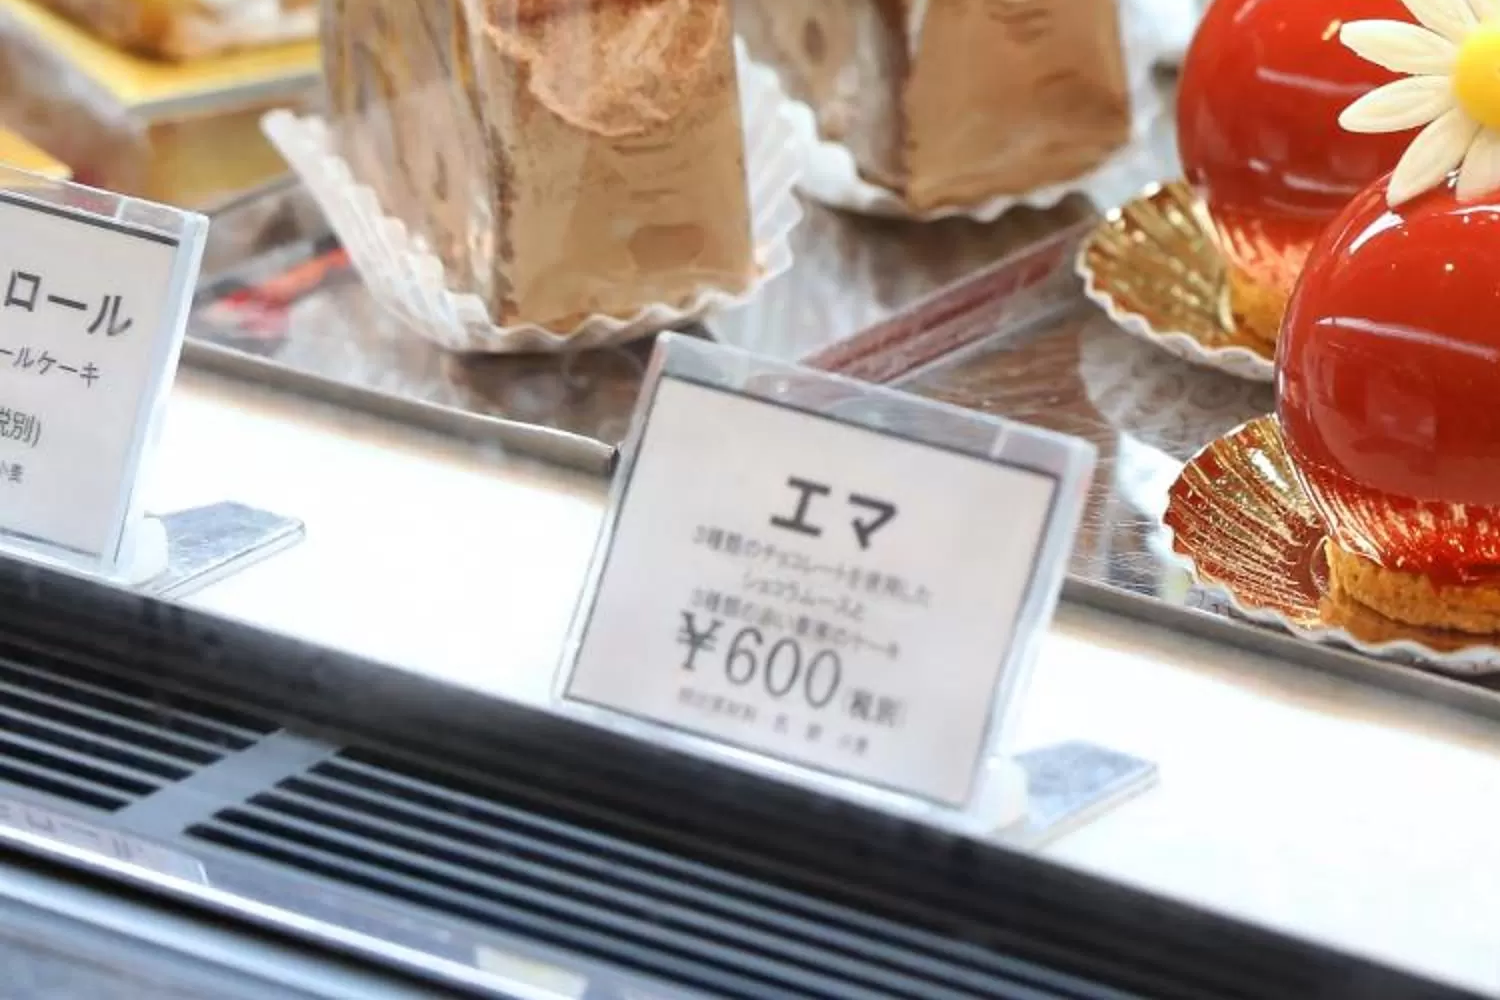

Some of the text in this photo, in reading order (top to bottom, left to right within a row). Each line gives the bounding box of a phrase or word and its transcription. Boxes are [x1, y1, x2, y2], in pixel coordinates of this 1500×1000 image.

[4, 269, 133, 337] ロール
[769, 476, 898, 550] エマ
